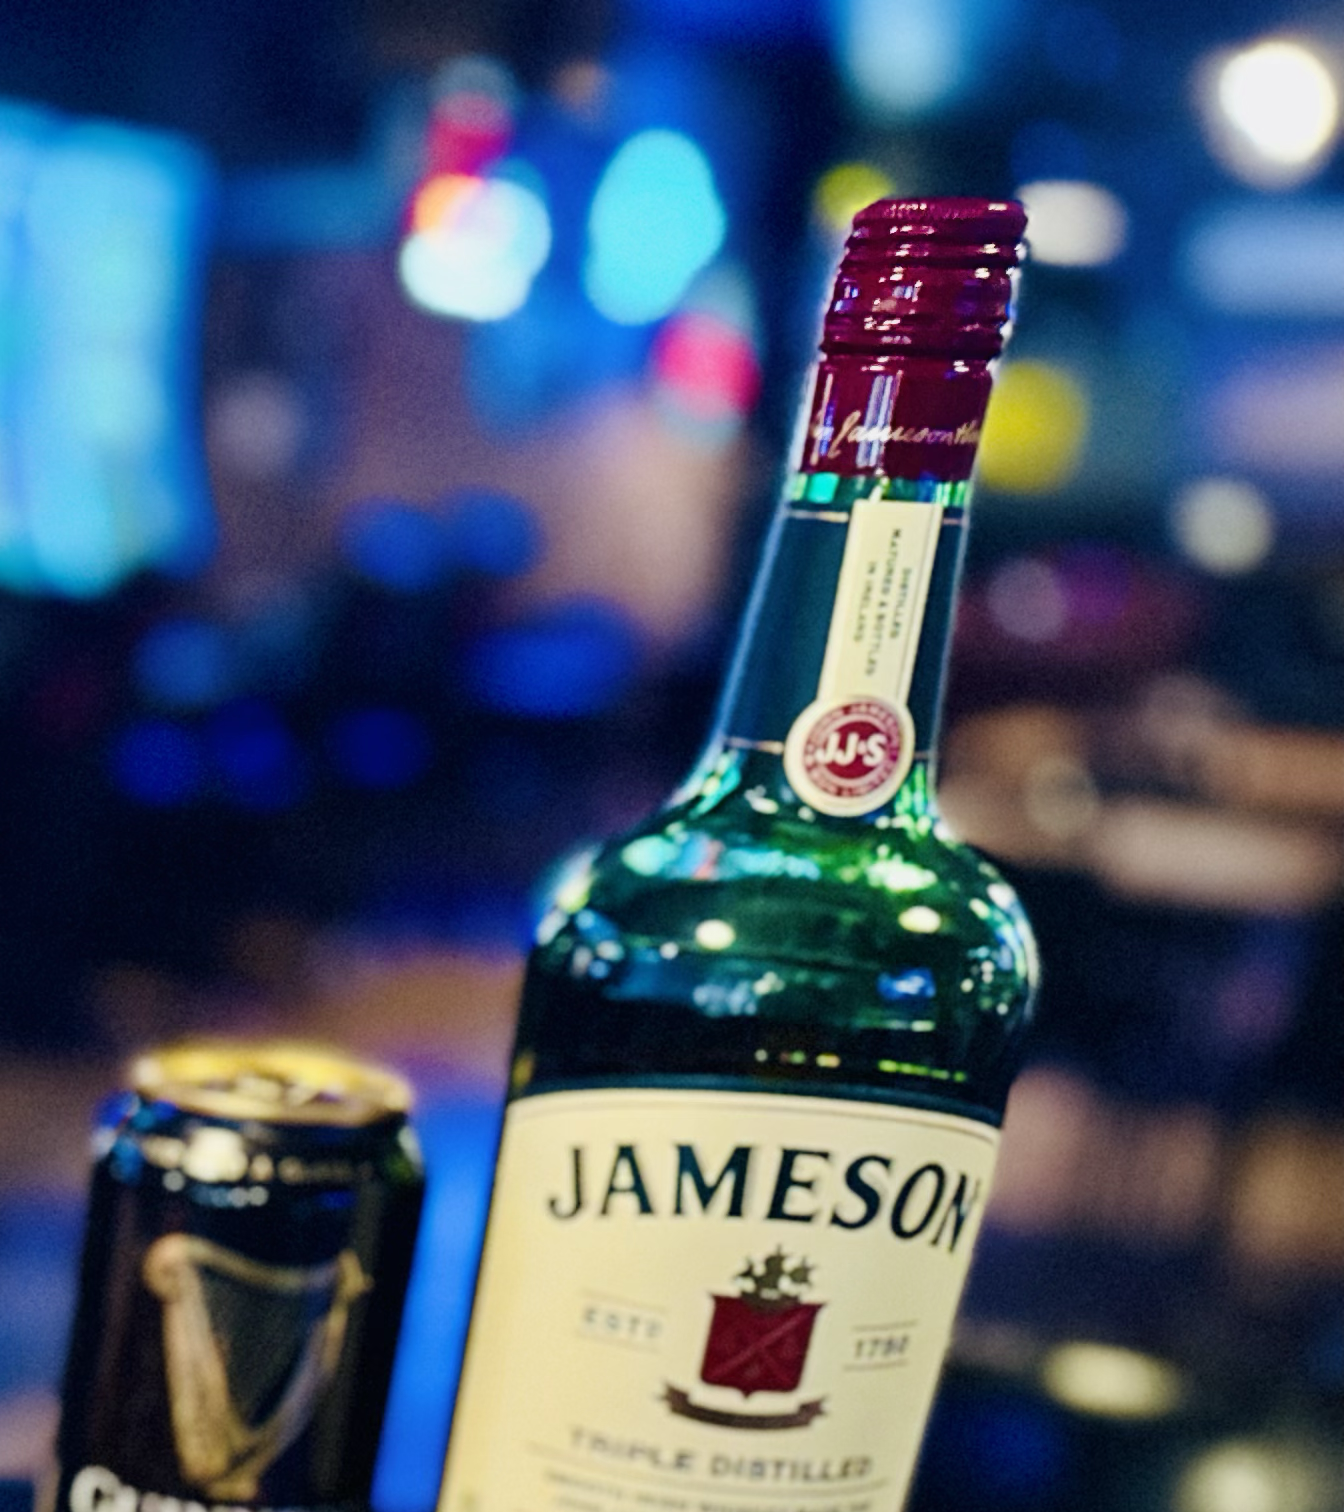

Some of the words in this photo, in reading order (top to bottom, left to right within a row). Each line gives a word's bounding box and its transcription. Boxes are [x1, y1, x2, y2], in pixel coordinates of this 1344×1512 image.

[547, 1143, 983, 1256] JAMESON
[570, 1427, 694, 1471] TRIPLE
[711, 1455, 875, 1484] DISTILLED
